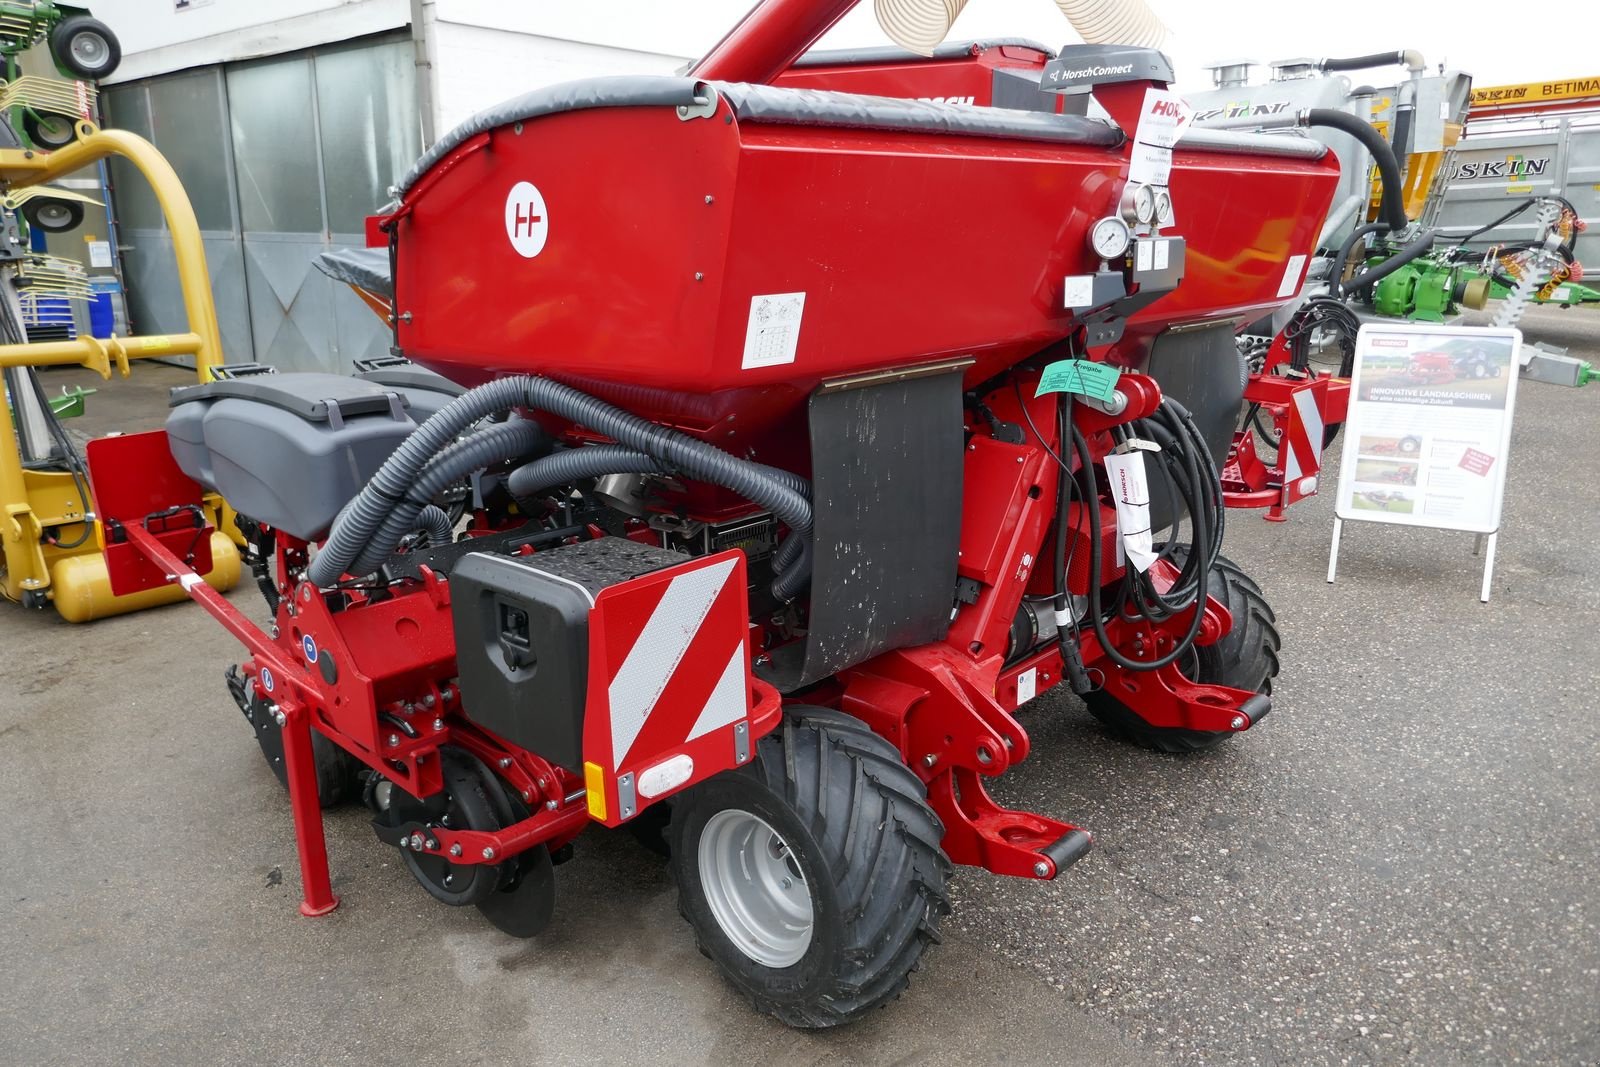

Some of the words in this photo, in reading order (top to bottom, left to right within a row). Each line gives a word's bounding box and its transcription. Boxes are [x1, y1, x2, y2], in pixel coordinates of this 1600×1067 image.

[1062, 63, 1134, 81] HorschConnect
[1542, 80, 1600, 96] BETIMA
[1077, 363, 1102, 375] Freigabe
[1370, 387, 1418, 397] INNOVATIVE
[1419, 389, 1492, 401] LANDMASCHINEN
[1429, 398, 1454, 406] Zukunft
[1120, 468, 1128, 497] HORSCH
